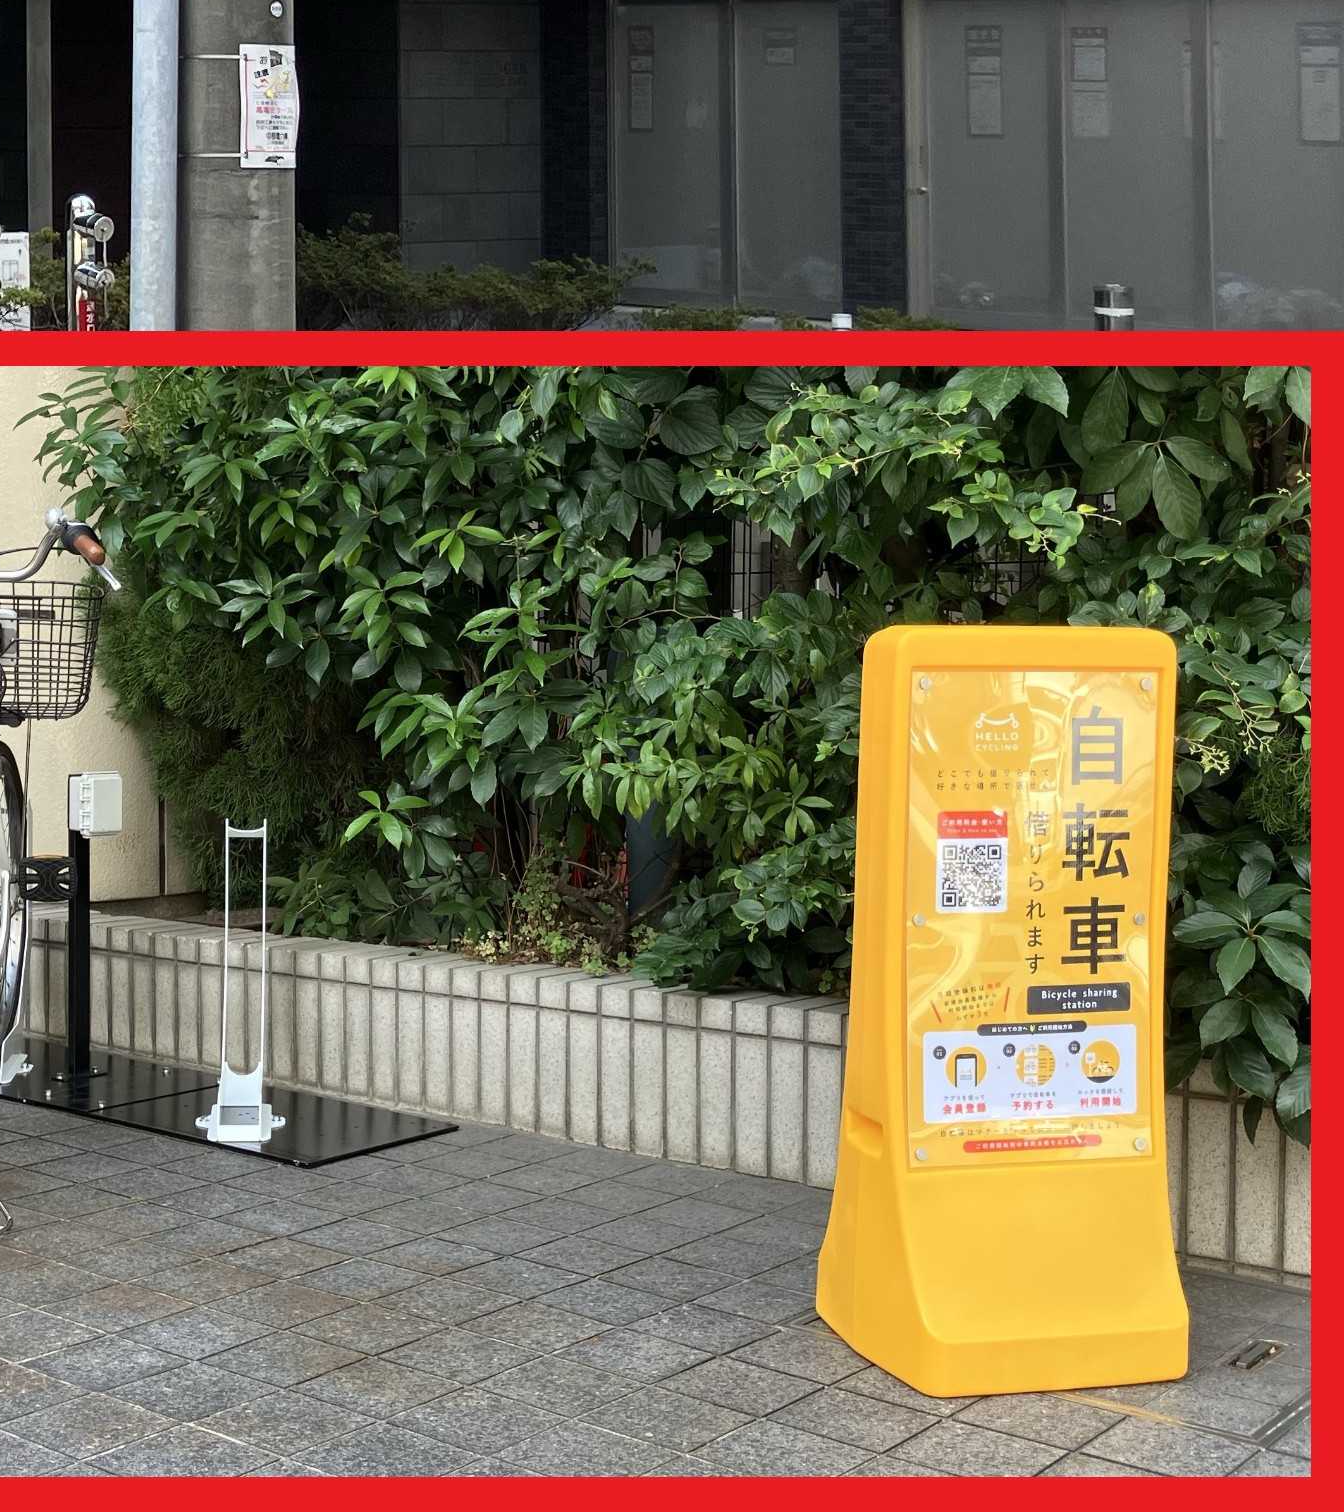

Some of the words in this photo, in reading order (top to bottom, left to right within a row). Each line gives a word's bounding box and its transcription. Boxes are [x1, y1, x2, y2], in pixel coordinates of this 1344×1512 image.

[975, 731, 1019, 741] HELLO
[975, 743, 1019, 752] CYCLING
[1061, 704, 1130, 975] 自転車
[1024, 810, 1049, 975] 借りられます
[1041, 990, 1078, 1000] Bicycle
[1082, 988, 1118, 999] sharing
[1061, 1001, 1098, 1010] station
[1012, 1099, 1054, 1111] 予約する
[1079, 1096, 1122, 1108] 利用開始
